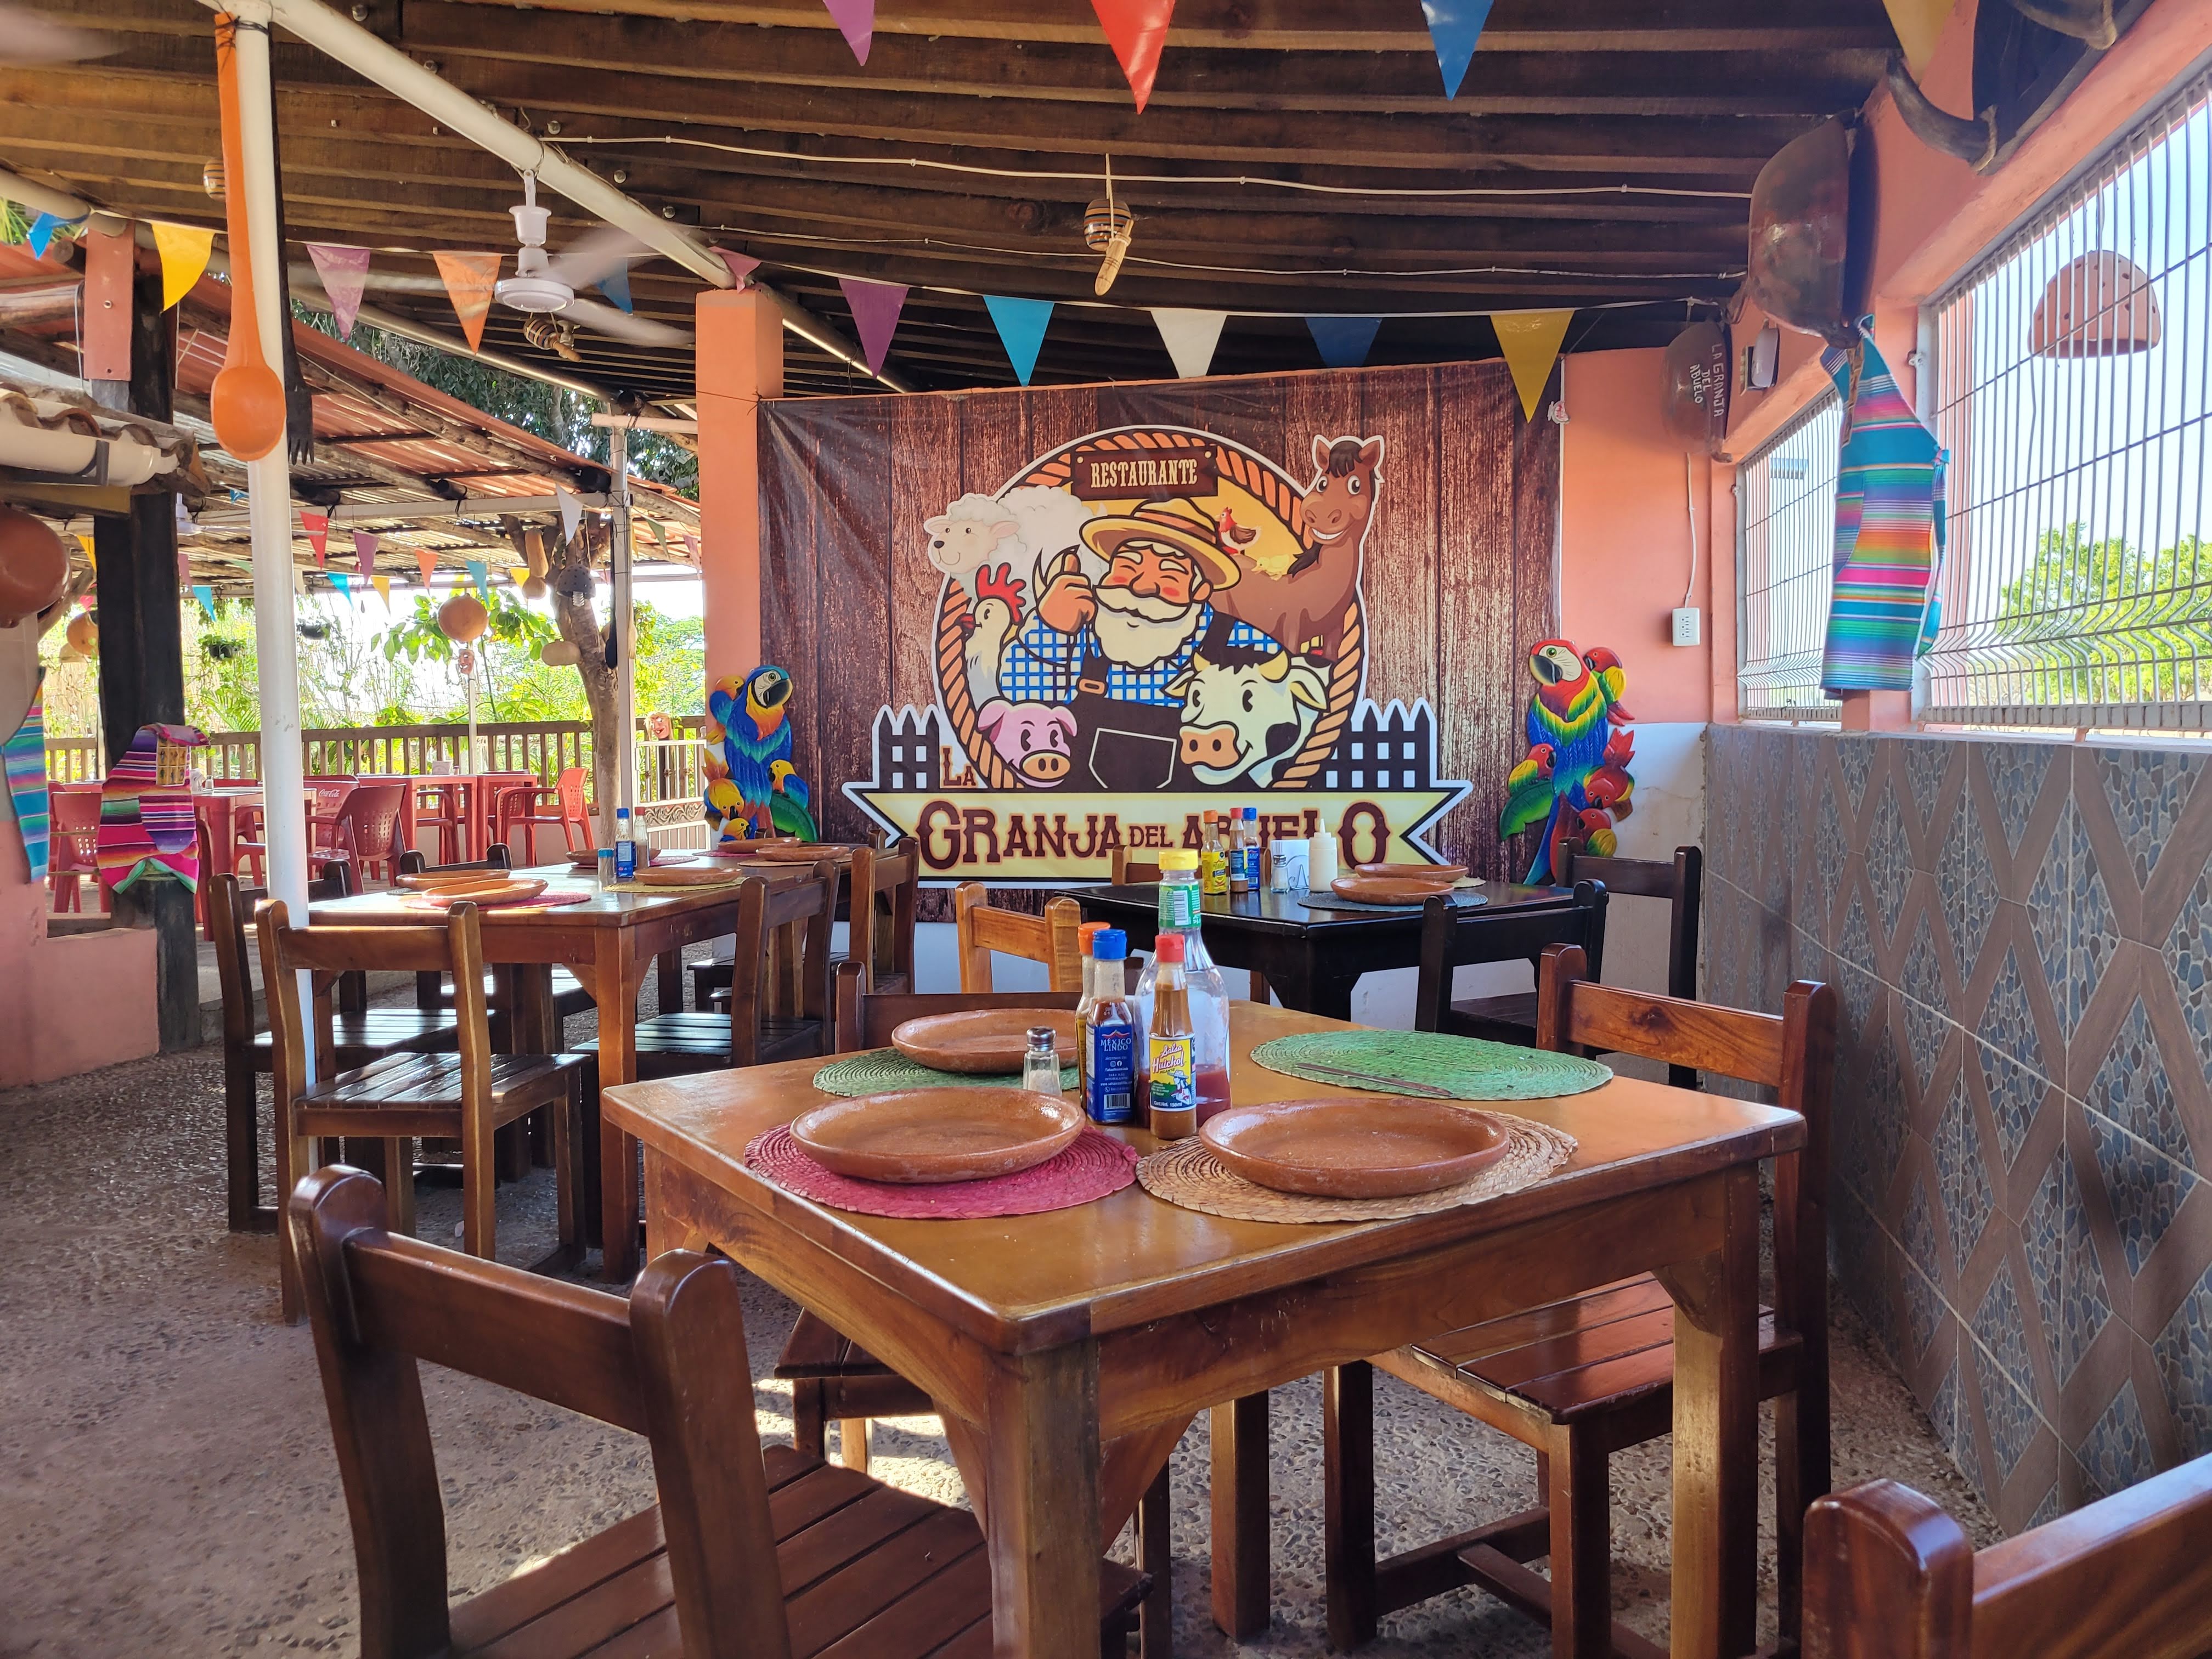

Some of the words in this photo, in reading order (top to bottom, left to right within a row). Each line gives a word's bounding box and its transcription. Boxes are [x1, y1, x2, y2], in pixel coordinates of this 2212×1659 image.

[1712, 343, 1723, 360] LA
[1690, 364, 1703, 404] ABUELO
[1701, 369, 1712, 391] DEL
[1713, 363, 1725, 417] GRANJA
[1090, 459, 1198, 488] RESTAURANTE
[942, 748, 976, 786] LA
[916, 800, 1121, 870] GRANJA
[1129, 825, 1173, 848] DEL
[1104, 1043, 1128, 1052] LINDO
[1161, 1042, 1183, 1058] Salsa
[1152, 1051, 1184, 1073] Huichol
